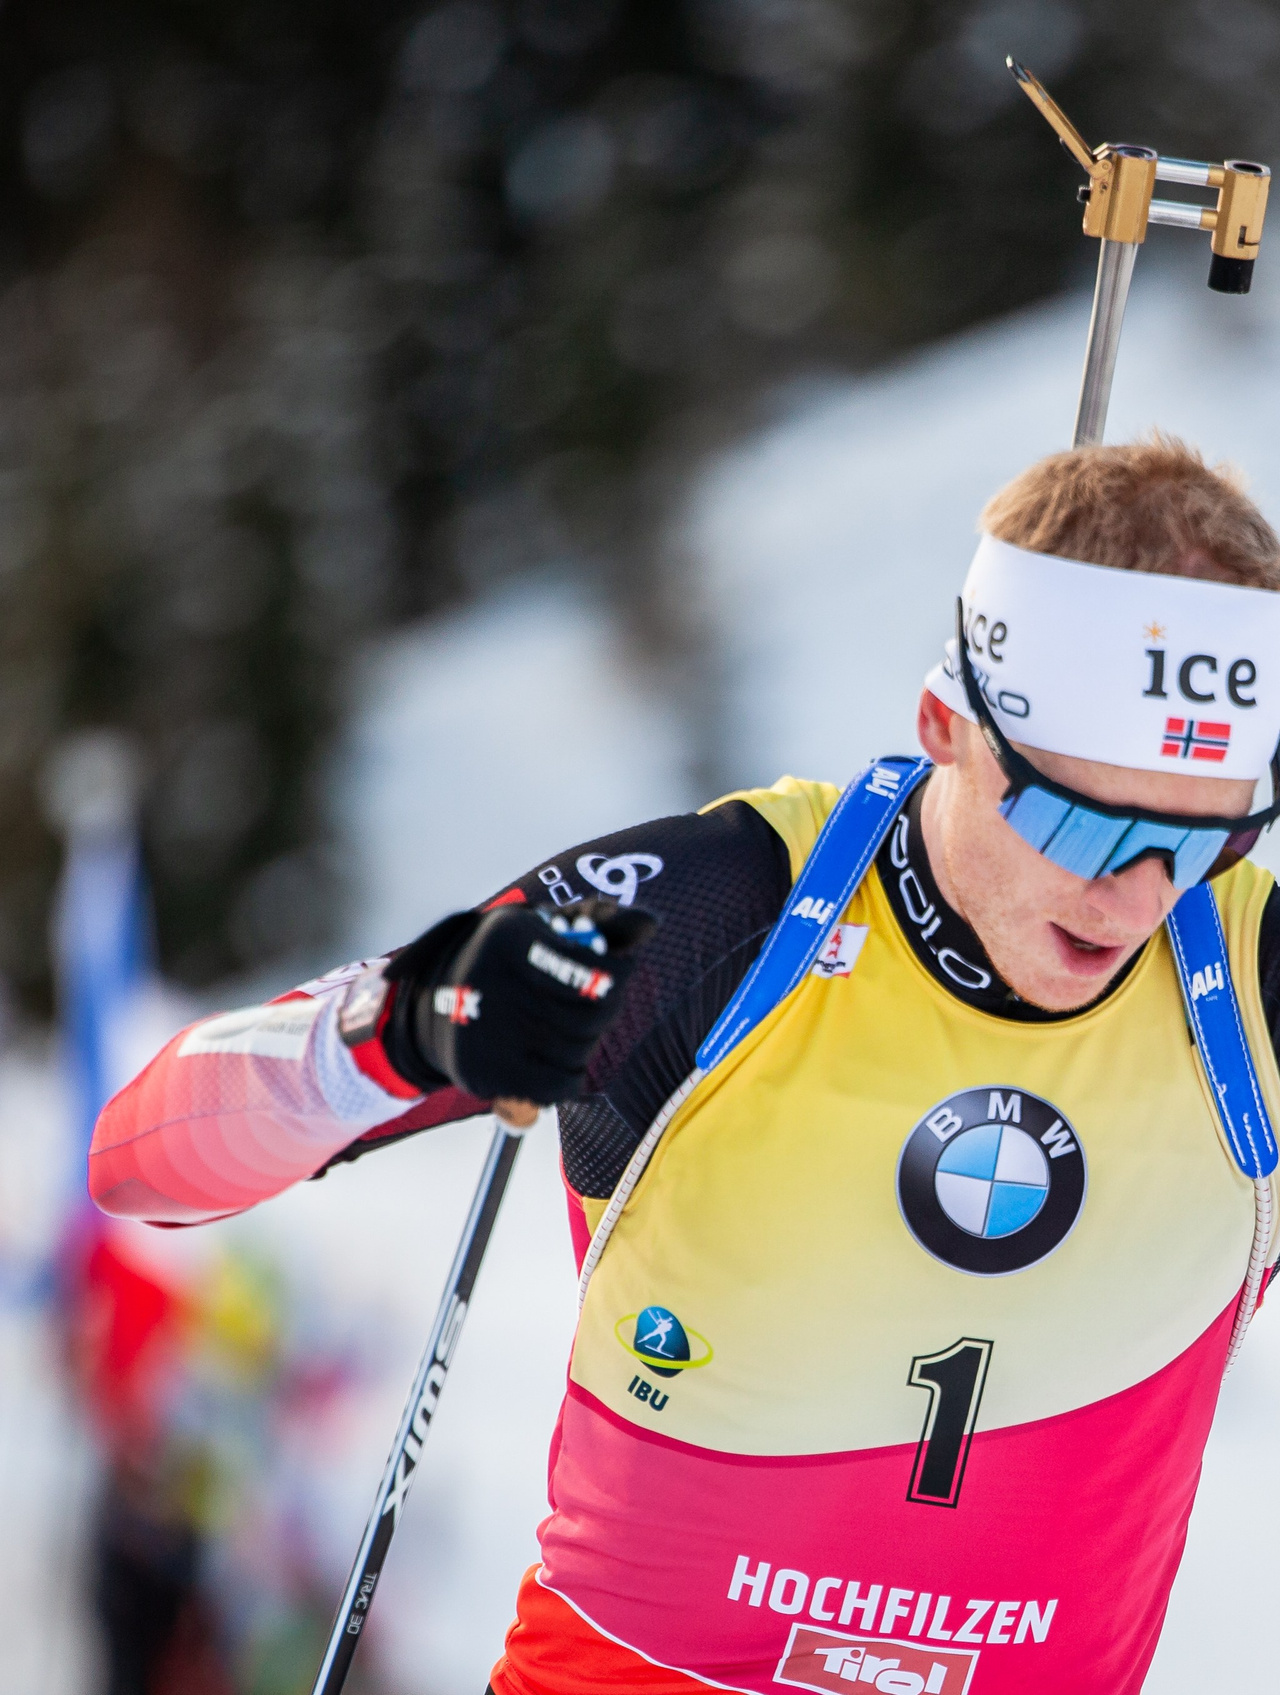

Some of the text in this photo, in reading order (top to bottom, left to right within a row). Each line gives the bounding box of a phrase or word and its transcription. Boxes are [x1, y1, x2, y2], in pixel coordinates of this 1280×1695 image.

[1142, 621, 1259, 709] ice
[925, 1090, 1077, 1160] BMW
[627, 1374, 670, 1412] IBU
[906, 1336, 994, 1509] 1
[727, 1554, 1059, 1644] HOCHFILZEN
